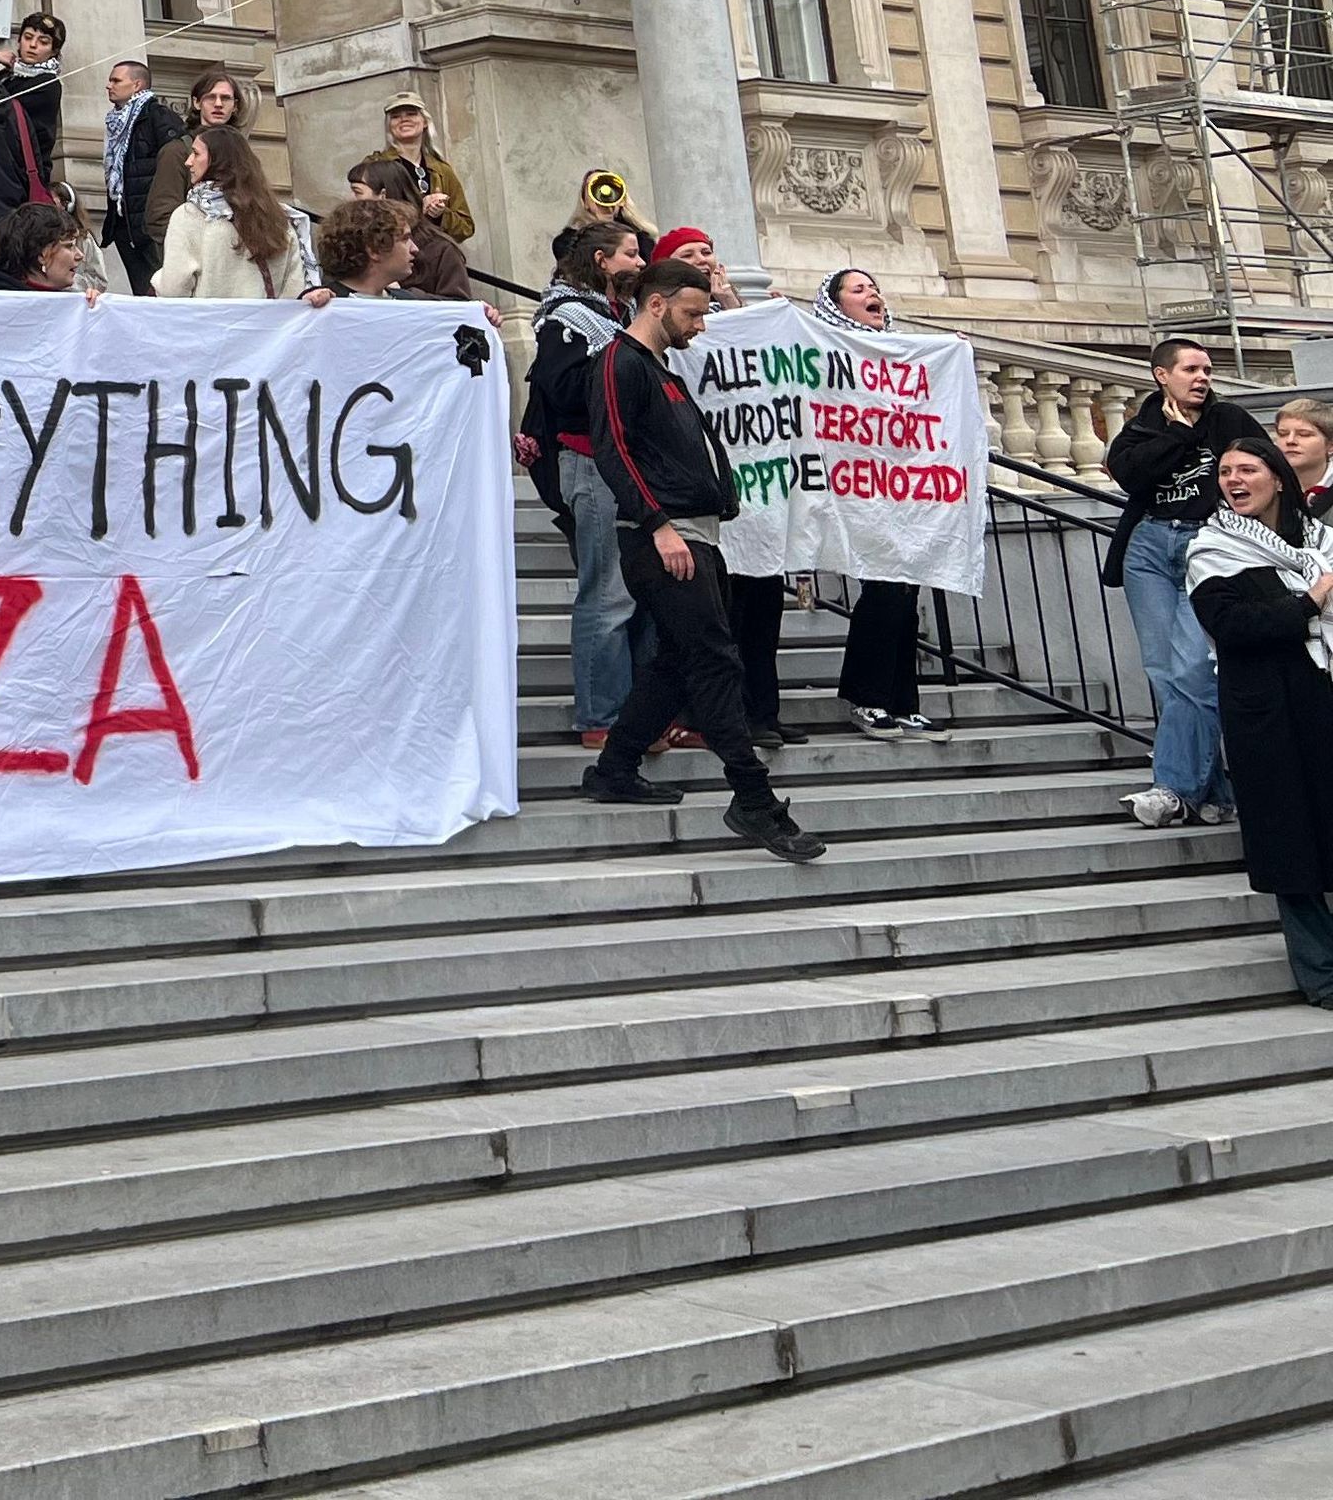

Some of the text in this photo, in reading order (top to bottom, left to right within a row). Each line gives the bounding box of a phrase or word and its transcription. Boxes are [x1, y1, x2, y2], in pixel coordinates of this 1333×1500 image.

[697, 342, 931, 401] ALLE UNIS IN GAZA
[830, 460, 969, 505] GENOZID!
